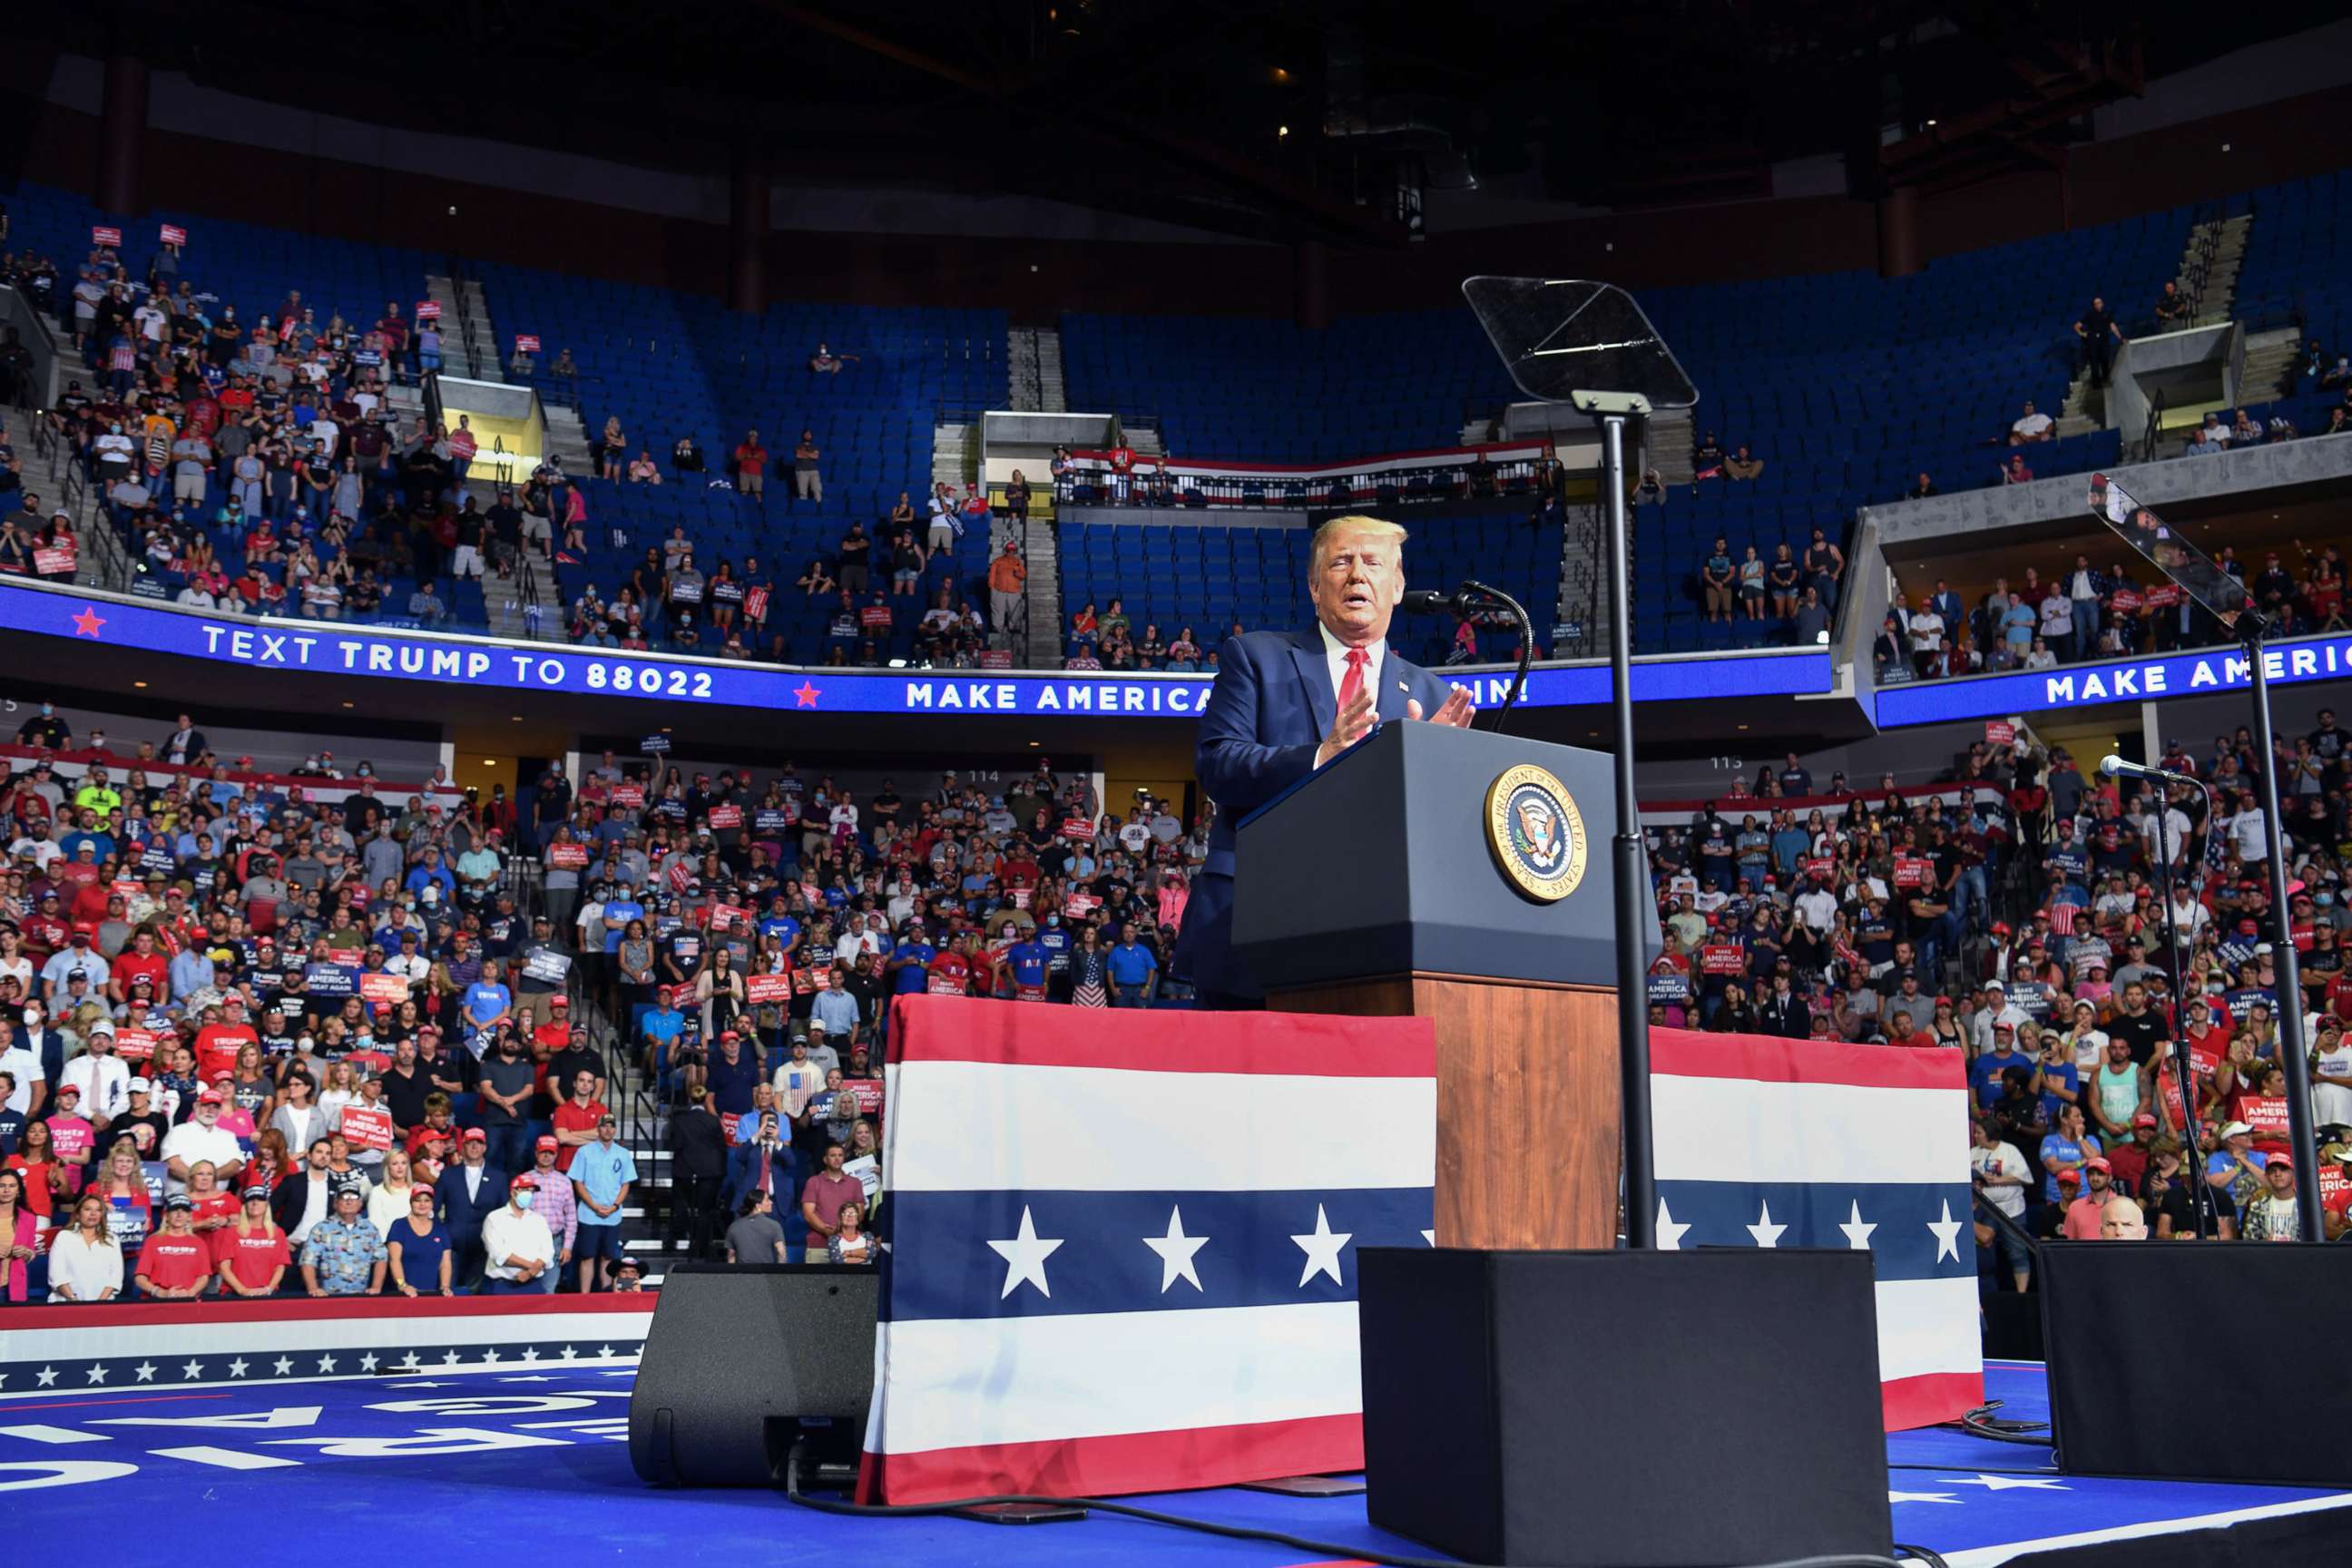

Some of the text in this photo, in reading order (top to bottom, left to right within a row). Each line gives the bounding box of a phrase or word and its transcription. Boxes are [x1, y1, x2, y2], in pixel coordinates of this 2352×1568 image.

[203, 625, 713, 697] TEXT TRUMP TO 88022
[2047, 664, 2167, 703] MAKE
[906, 684, 1015, 709] MAKE
[968, 770, 1000, 782] 114
[307, 975, 352, 987] AMERICA
[362, 983, 406, 994] AMERICA
[750, 983, 788, 995] AMERICA
[930, 985, 964, 996] AMERICA
[1648, 985, 1688, 995] AMERICA
[345, 1118, 388, 1138] AMERICA
